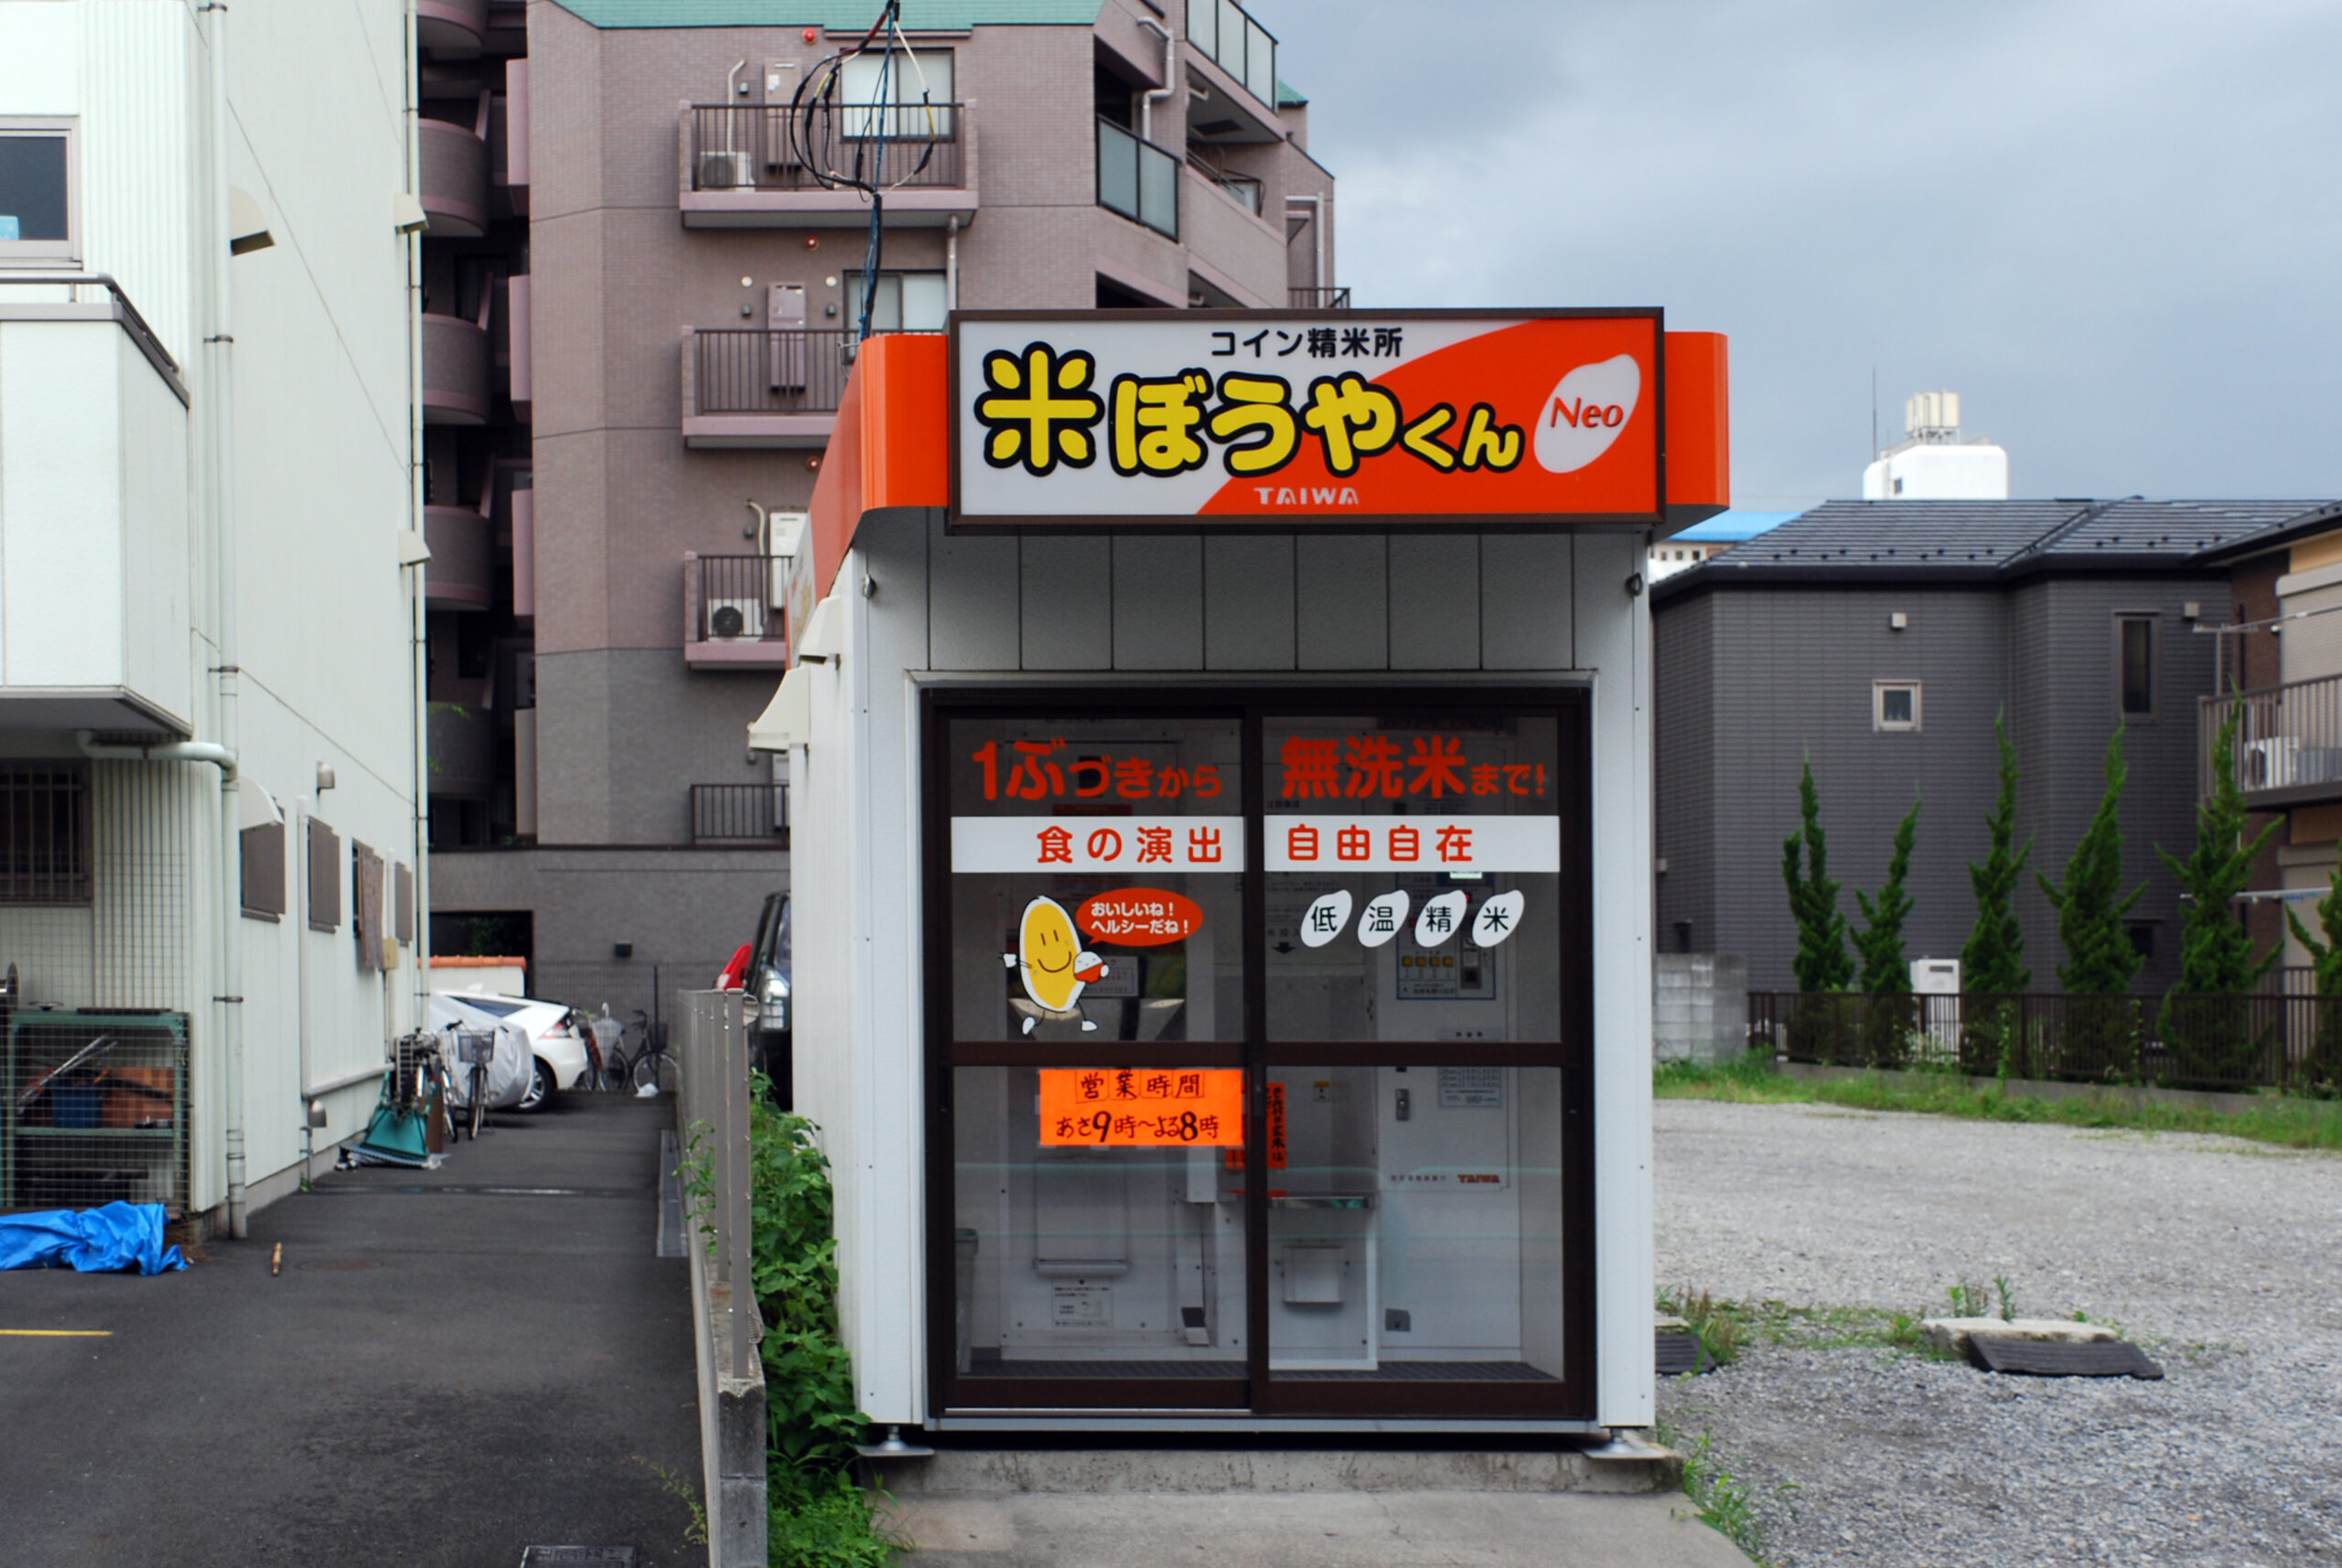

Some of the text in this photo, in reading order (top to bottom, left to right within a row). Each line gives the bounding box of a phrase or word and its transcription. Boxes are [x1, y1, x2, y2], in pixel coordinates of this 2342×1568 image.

[1210, 327, 1403, 359] コイン精米所
[973, 341, 1526, 477] 米ぼうやくん
[1550, 395, 1625, 429] Neo
[1252, 487, 1359, 505] TAIWA
[972, 735, 1545, 800] 1ぶづきから 無洗米まで!
[1037, 823, 1475, 864] 食の演出 自由自在
[1090, 901, 1174, 917] おいしいね！
[1310, 905, 1509, 933] 低温精米
[1090, 918, 1189, 934] ヘルシーだね！
[1080, 1068, 1200, 1100] 営業時間
[1457, 1174, 1500, 1184] TAIWA
